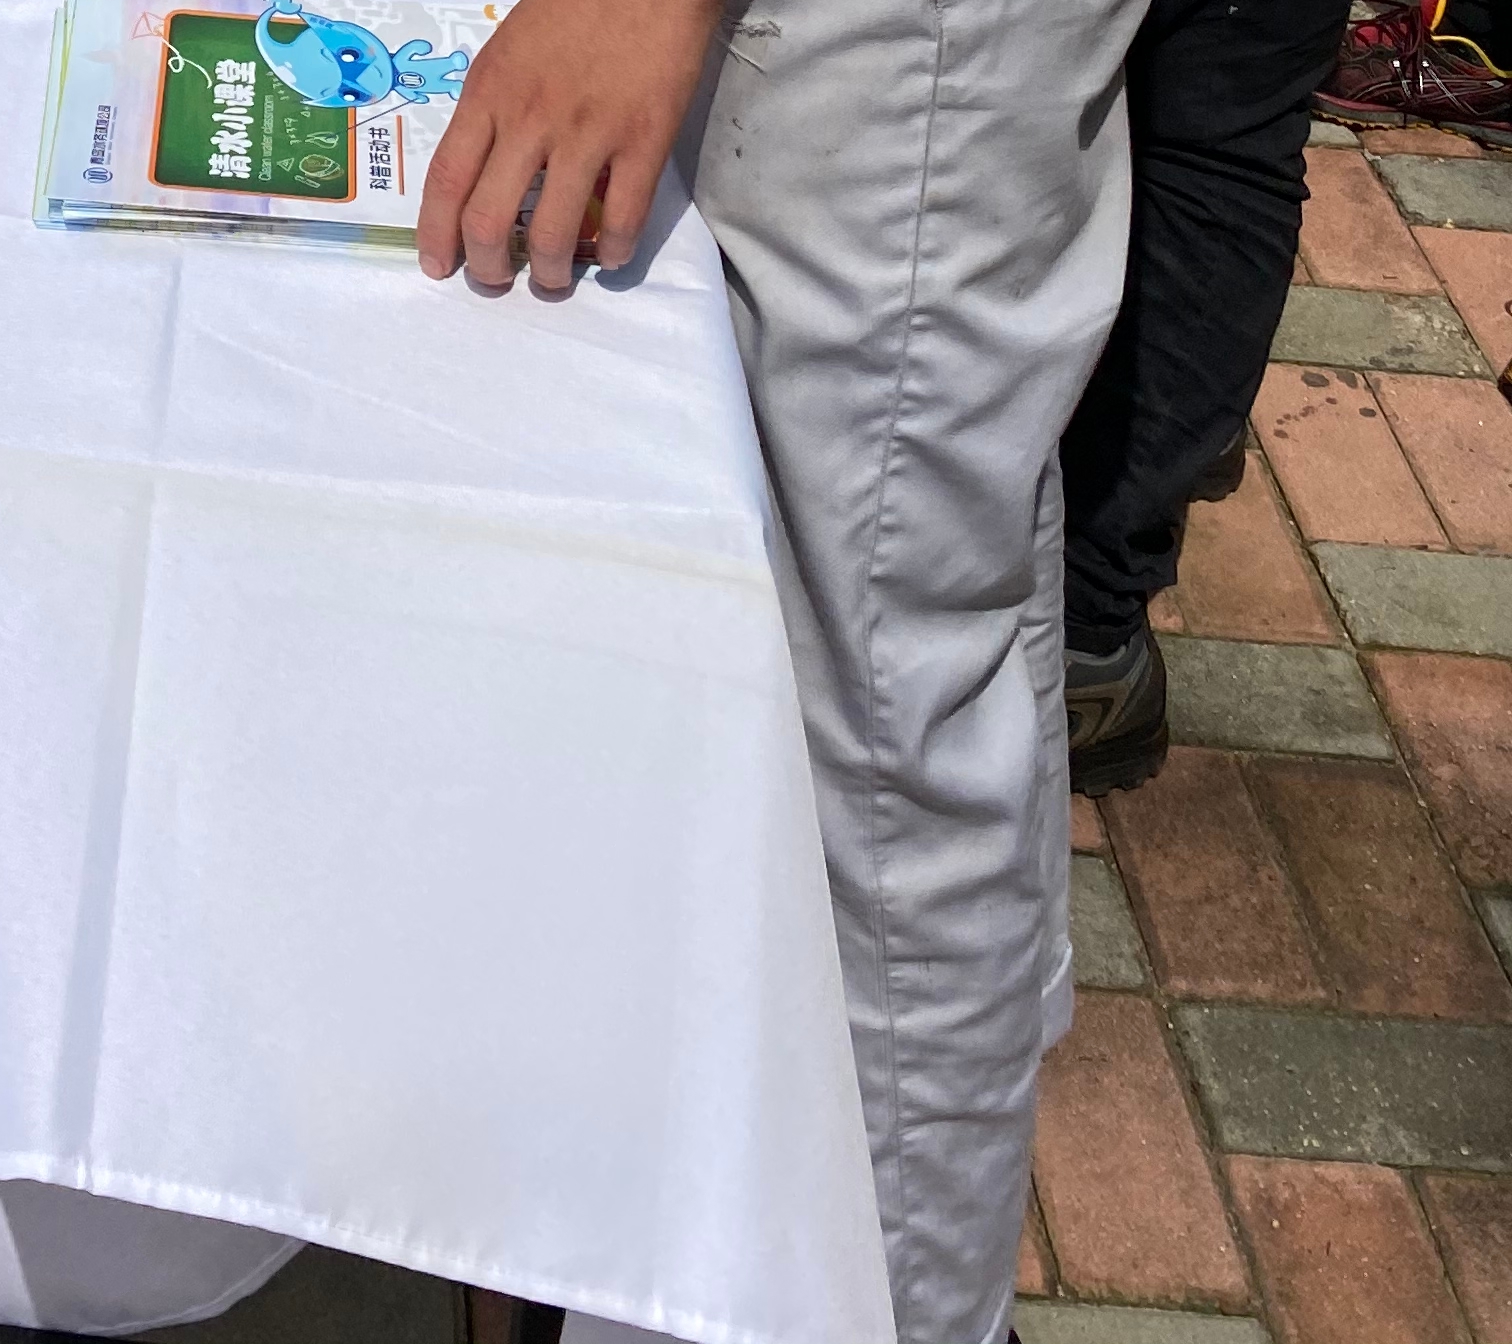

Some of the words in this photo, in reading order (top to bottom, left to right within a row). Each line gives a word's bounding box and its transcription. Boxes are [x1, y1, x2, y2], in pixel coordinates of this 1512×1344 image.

[208, 58, 259, 180] 清水小课堂
[261, 95, 274, 134] classroom
[260, 135, 272, 157] water
[367, 127, 392, 192] 科普活动书
[258, 159, 272, 181] Clean
